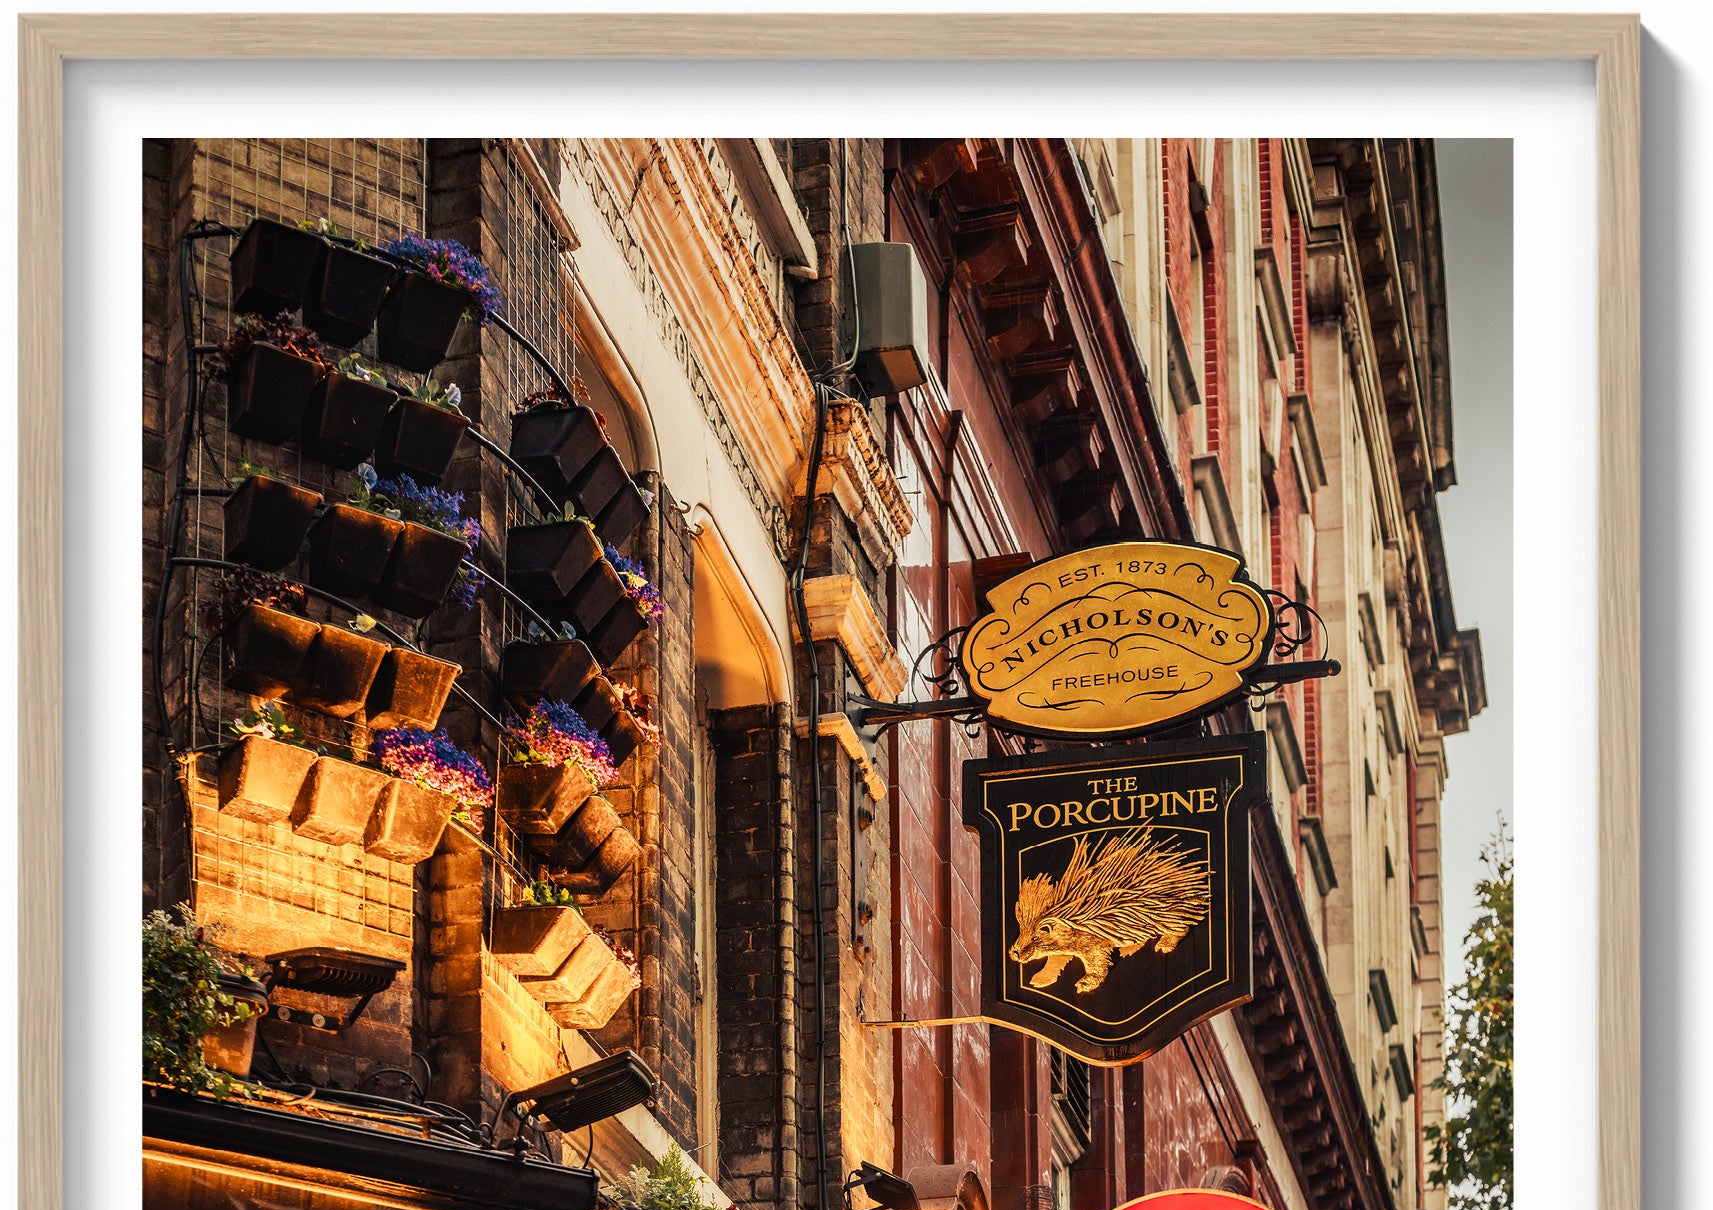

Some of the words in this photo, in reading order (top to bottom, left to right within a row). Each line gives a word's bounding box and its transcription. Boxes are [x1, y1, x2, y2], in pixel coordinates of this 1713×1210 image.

[1057, 564, 1105, 589] EST.
[1115, 560, 1168, 576] 1873
[1000, 608, 1230, 673] NICHOLSON'S
[1051, 664, 1180, 692] FREEHOUSE
[1087, 776, 1139, 796] THE
[1007, 787, 1219, 832] PORCUPINE
